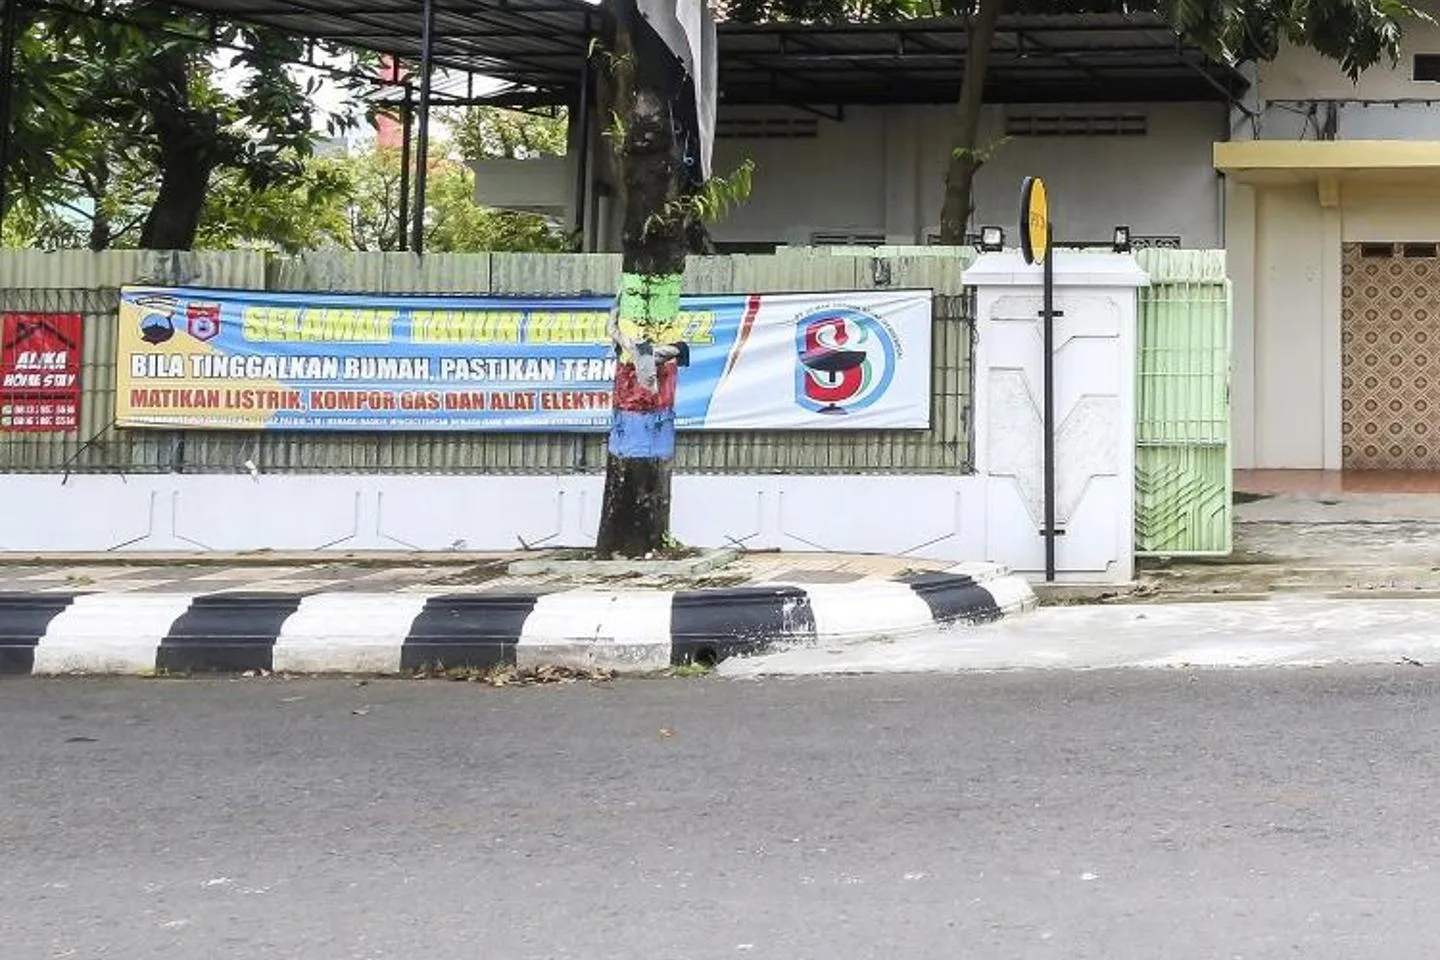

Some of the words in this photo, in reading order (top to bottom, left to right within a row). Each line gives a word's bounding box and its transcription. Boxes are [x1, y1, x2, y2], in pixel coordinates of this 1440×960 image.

[244, 307, 398, 343] SELAMAT
[131, 354, 185, 378] BILA
[190, 354, 339, 379] TINGGALKAN
[440, 358, 555, 381] PASTIKAN
[130, 389, 219, 408] MATIKAN
[224, 390, 306, 412] LISTRIK,
[310, 390, 395, 410] KOMPOR
[400, 390, 439, 410] GAS
[444, 391, 486, 411] DAN
[491, 391, 537, 410] ALAT
